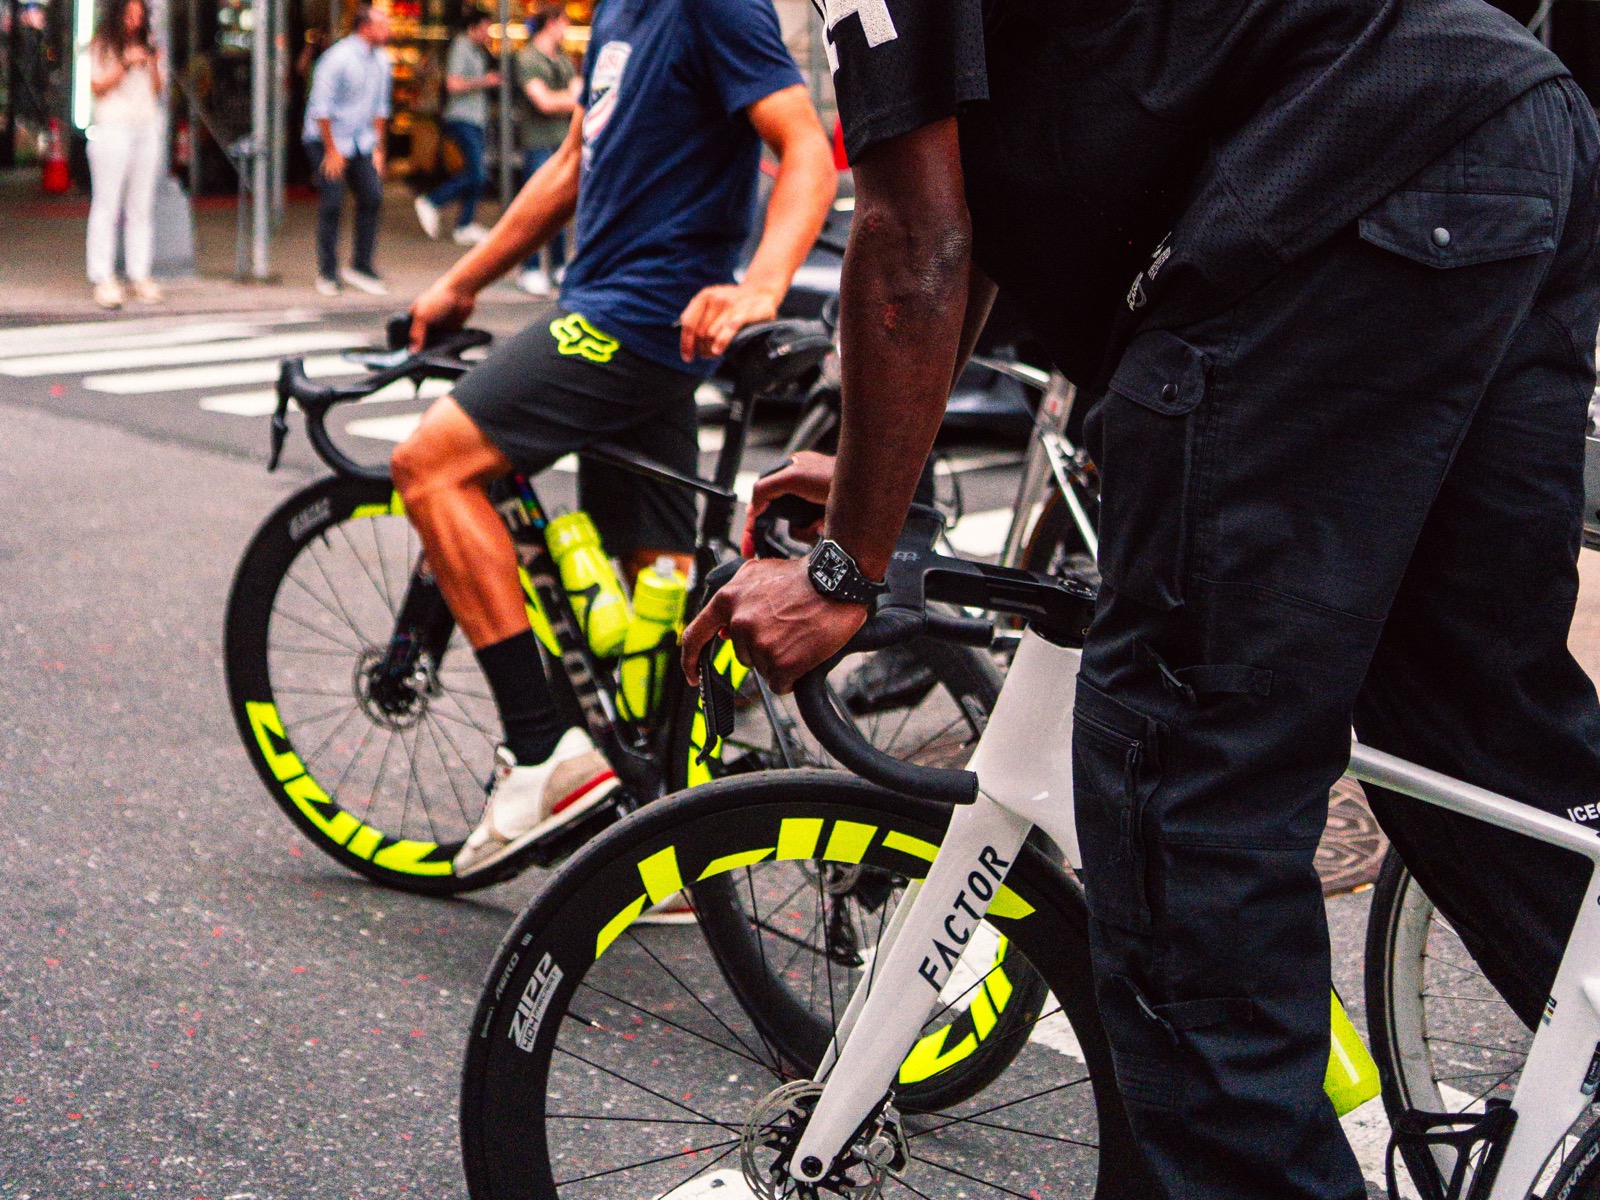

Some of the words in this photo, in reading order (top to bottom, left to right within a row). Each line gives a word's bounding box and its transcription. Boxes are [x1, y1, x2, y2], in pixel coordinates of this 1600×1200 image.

[1566, 801, 1600, 823] ICE
[917, 845, 1010, 994] FACTOR
[507, 951, 552, 1047] ZIPP
[522, 1015, 540, 1049] 404
